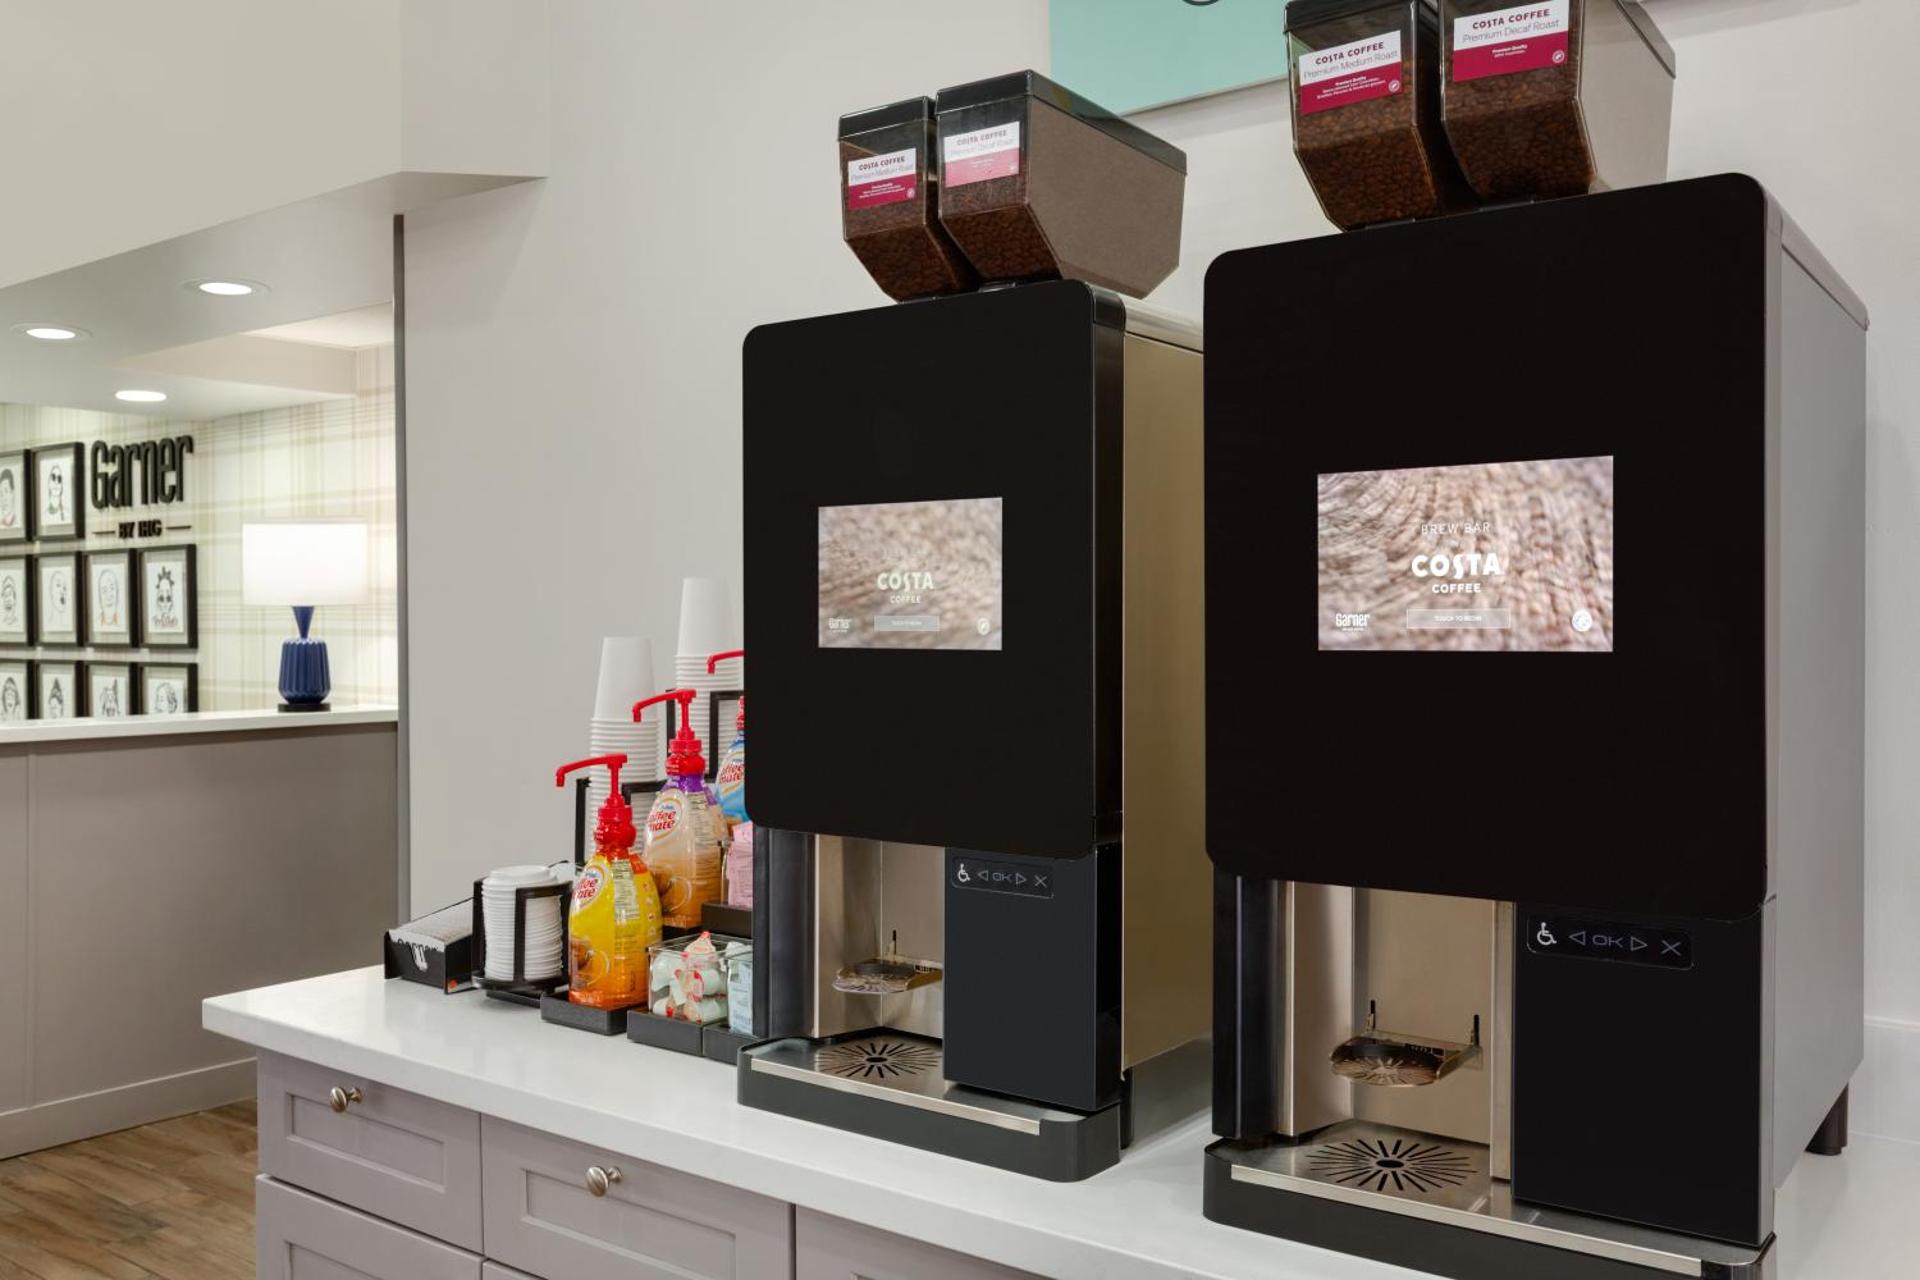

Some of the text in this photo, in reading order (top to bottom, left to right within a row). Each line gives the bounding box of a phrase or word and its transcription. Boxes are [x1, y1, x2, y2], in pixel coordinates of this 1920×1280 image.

[1472, 8, 1550, 30] COSTA COFFEE
[1462, 19, 1560, 43] Premium Decaf Roast
[1315, 41, 1384, 65] COSTA COFFEE
[1374, 50, 1398, 62] Roast
[981, 128, 1007, 141] COFFEE
[858, 155, 905, 171] COSTA COFFEE
[91, 435, 194, 510] Garner
[1421, 521, 1491, 536] BREW BAR
[1411, 552, 1503, 580] COSTA
[876, 571, 935, 592] COSTA
[1431, 583, 1482, 594] COFFEE
[889, 595, 921, 604] COFFEE
[1335, 612, 1370, 628] Garner
[992, 871, 1013, 883] OK
[1592, 933, 1624, 948] OK
